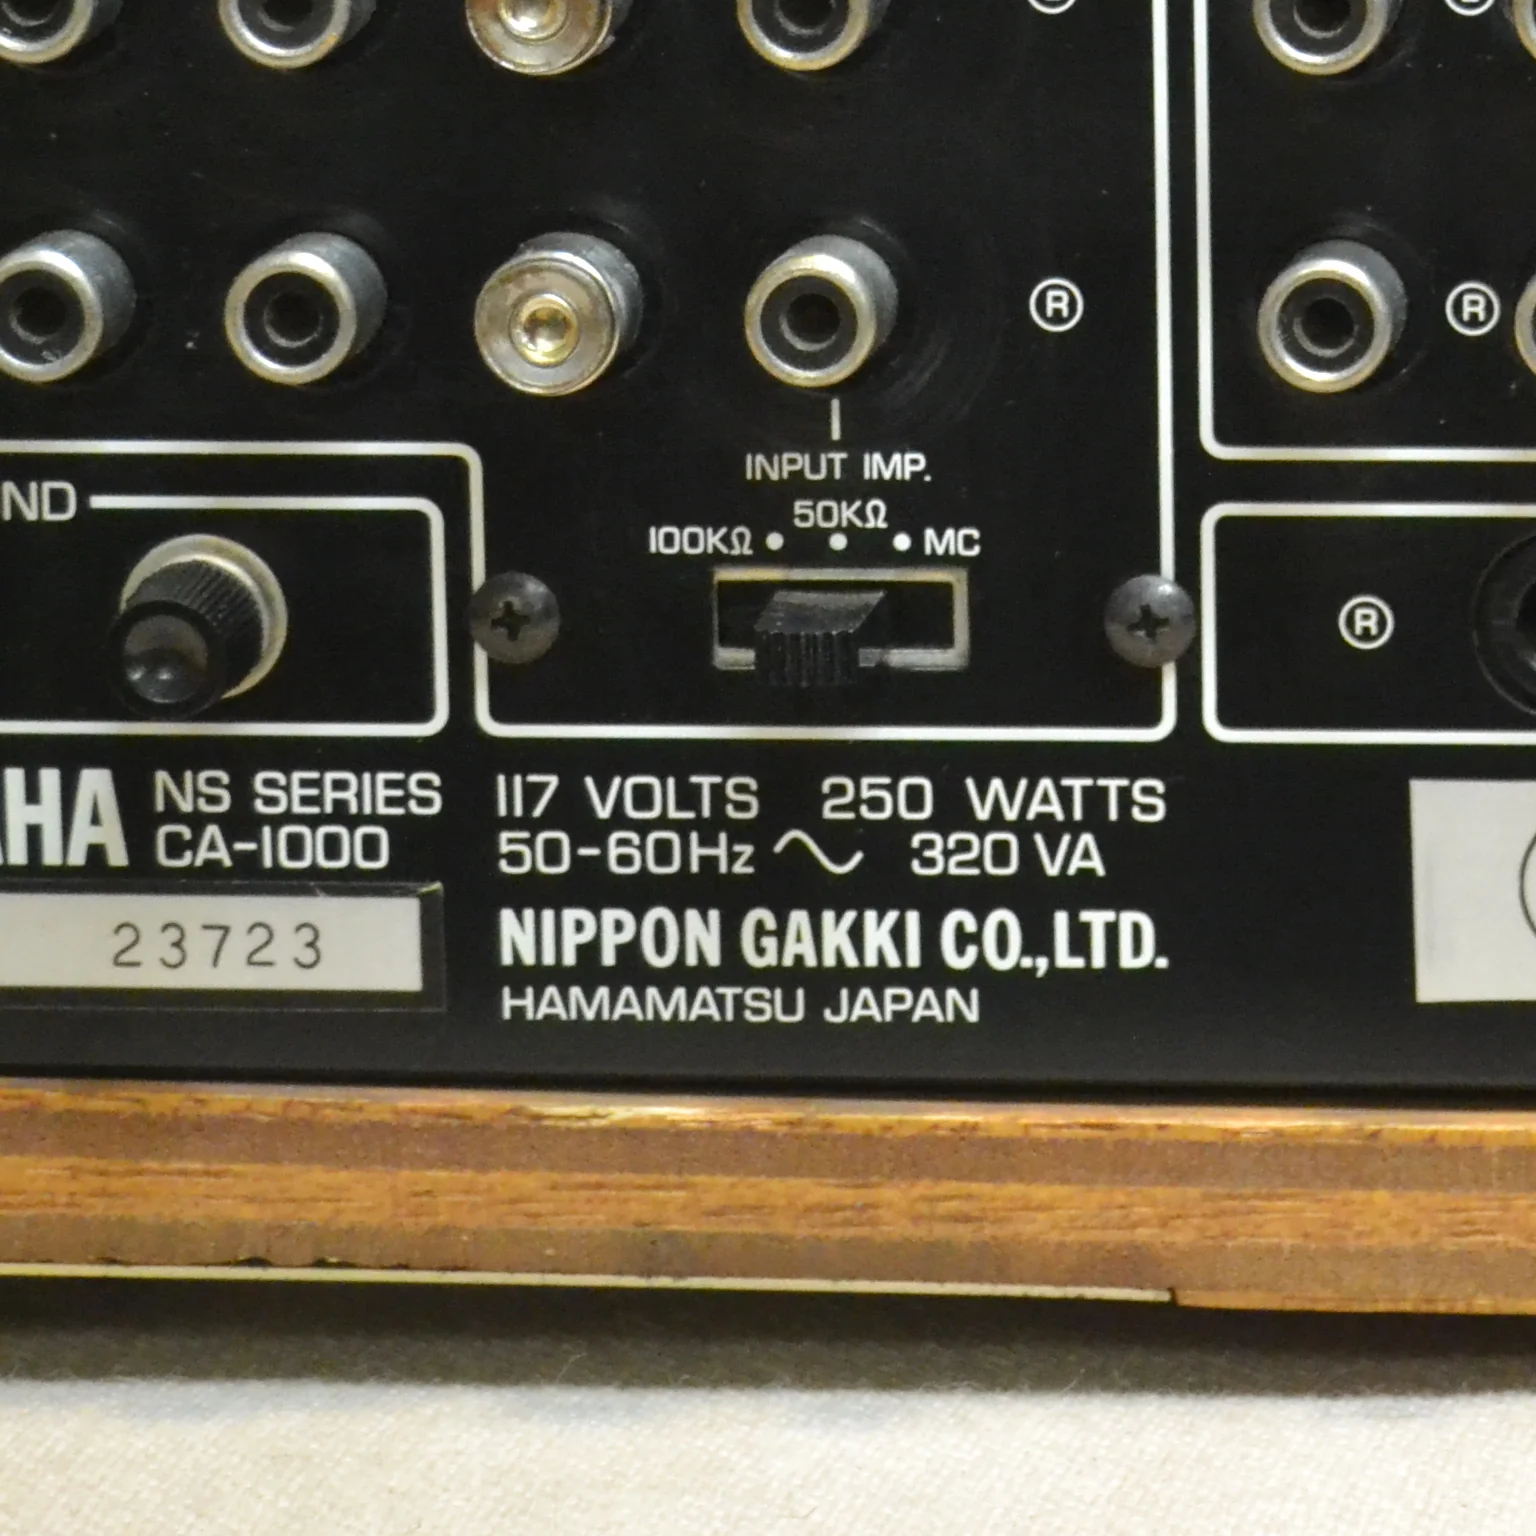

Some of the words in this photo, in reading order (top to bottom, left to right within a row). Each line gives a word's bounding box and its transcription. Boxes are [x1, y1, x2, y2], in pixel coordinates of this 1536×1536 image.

[746, 452, 850, 482] INPUT
[864, 452, 933, 483] IMP.
[2, 481, 78, 523] ND
[925, 528, 982, 558] MC
[155, 770, 233, 815] NS
[254, 771, 444, 817] SERIES
[498, 774, 560, 819] 117
[585, 776, 760, 821] VOLTS
[822, 776, 935, 822] 250
[966, 778, 1167, 824] WATTS
[0, 768, 130, 868] HA
[157, 825, 391, 871] CA-1000
[912, 832, 1020, 877] 320
[1034, 833, 1107, 878] VA
[113, 922, 323, 971] 23723
[500, 907, 722, 970] NIPPON
[741, 908, 922, 970] GAKKI
[941, 909, 1170, 979] CO.,LTD.
[503, 986, 806, 1024] HAMAMATSU
[824, 988, 981, 1025] JAPAN
